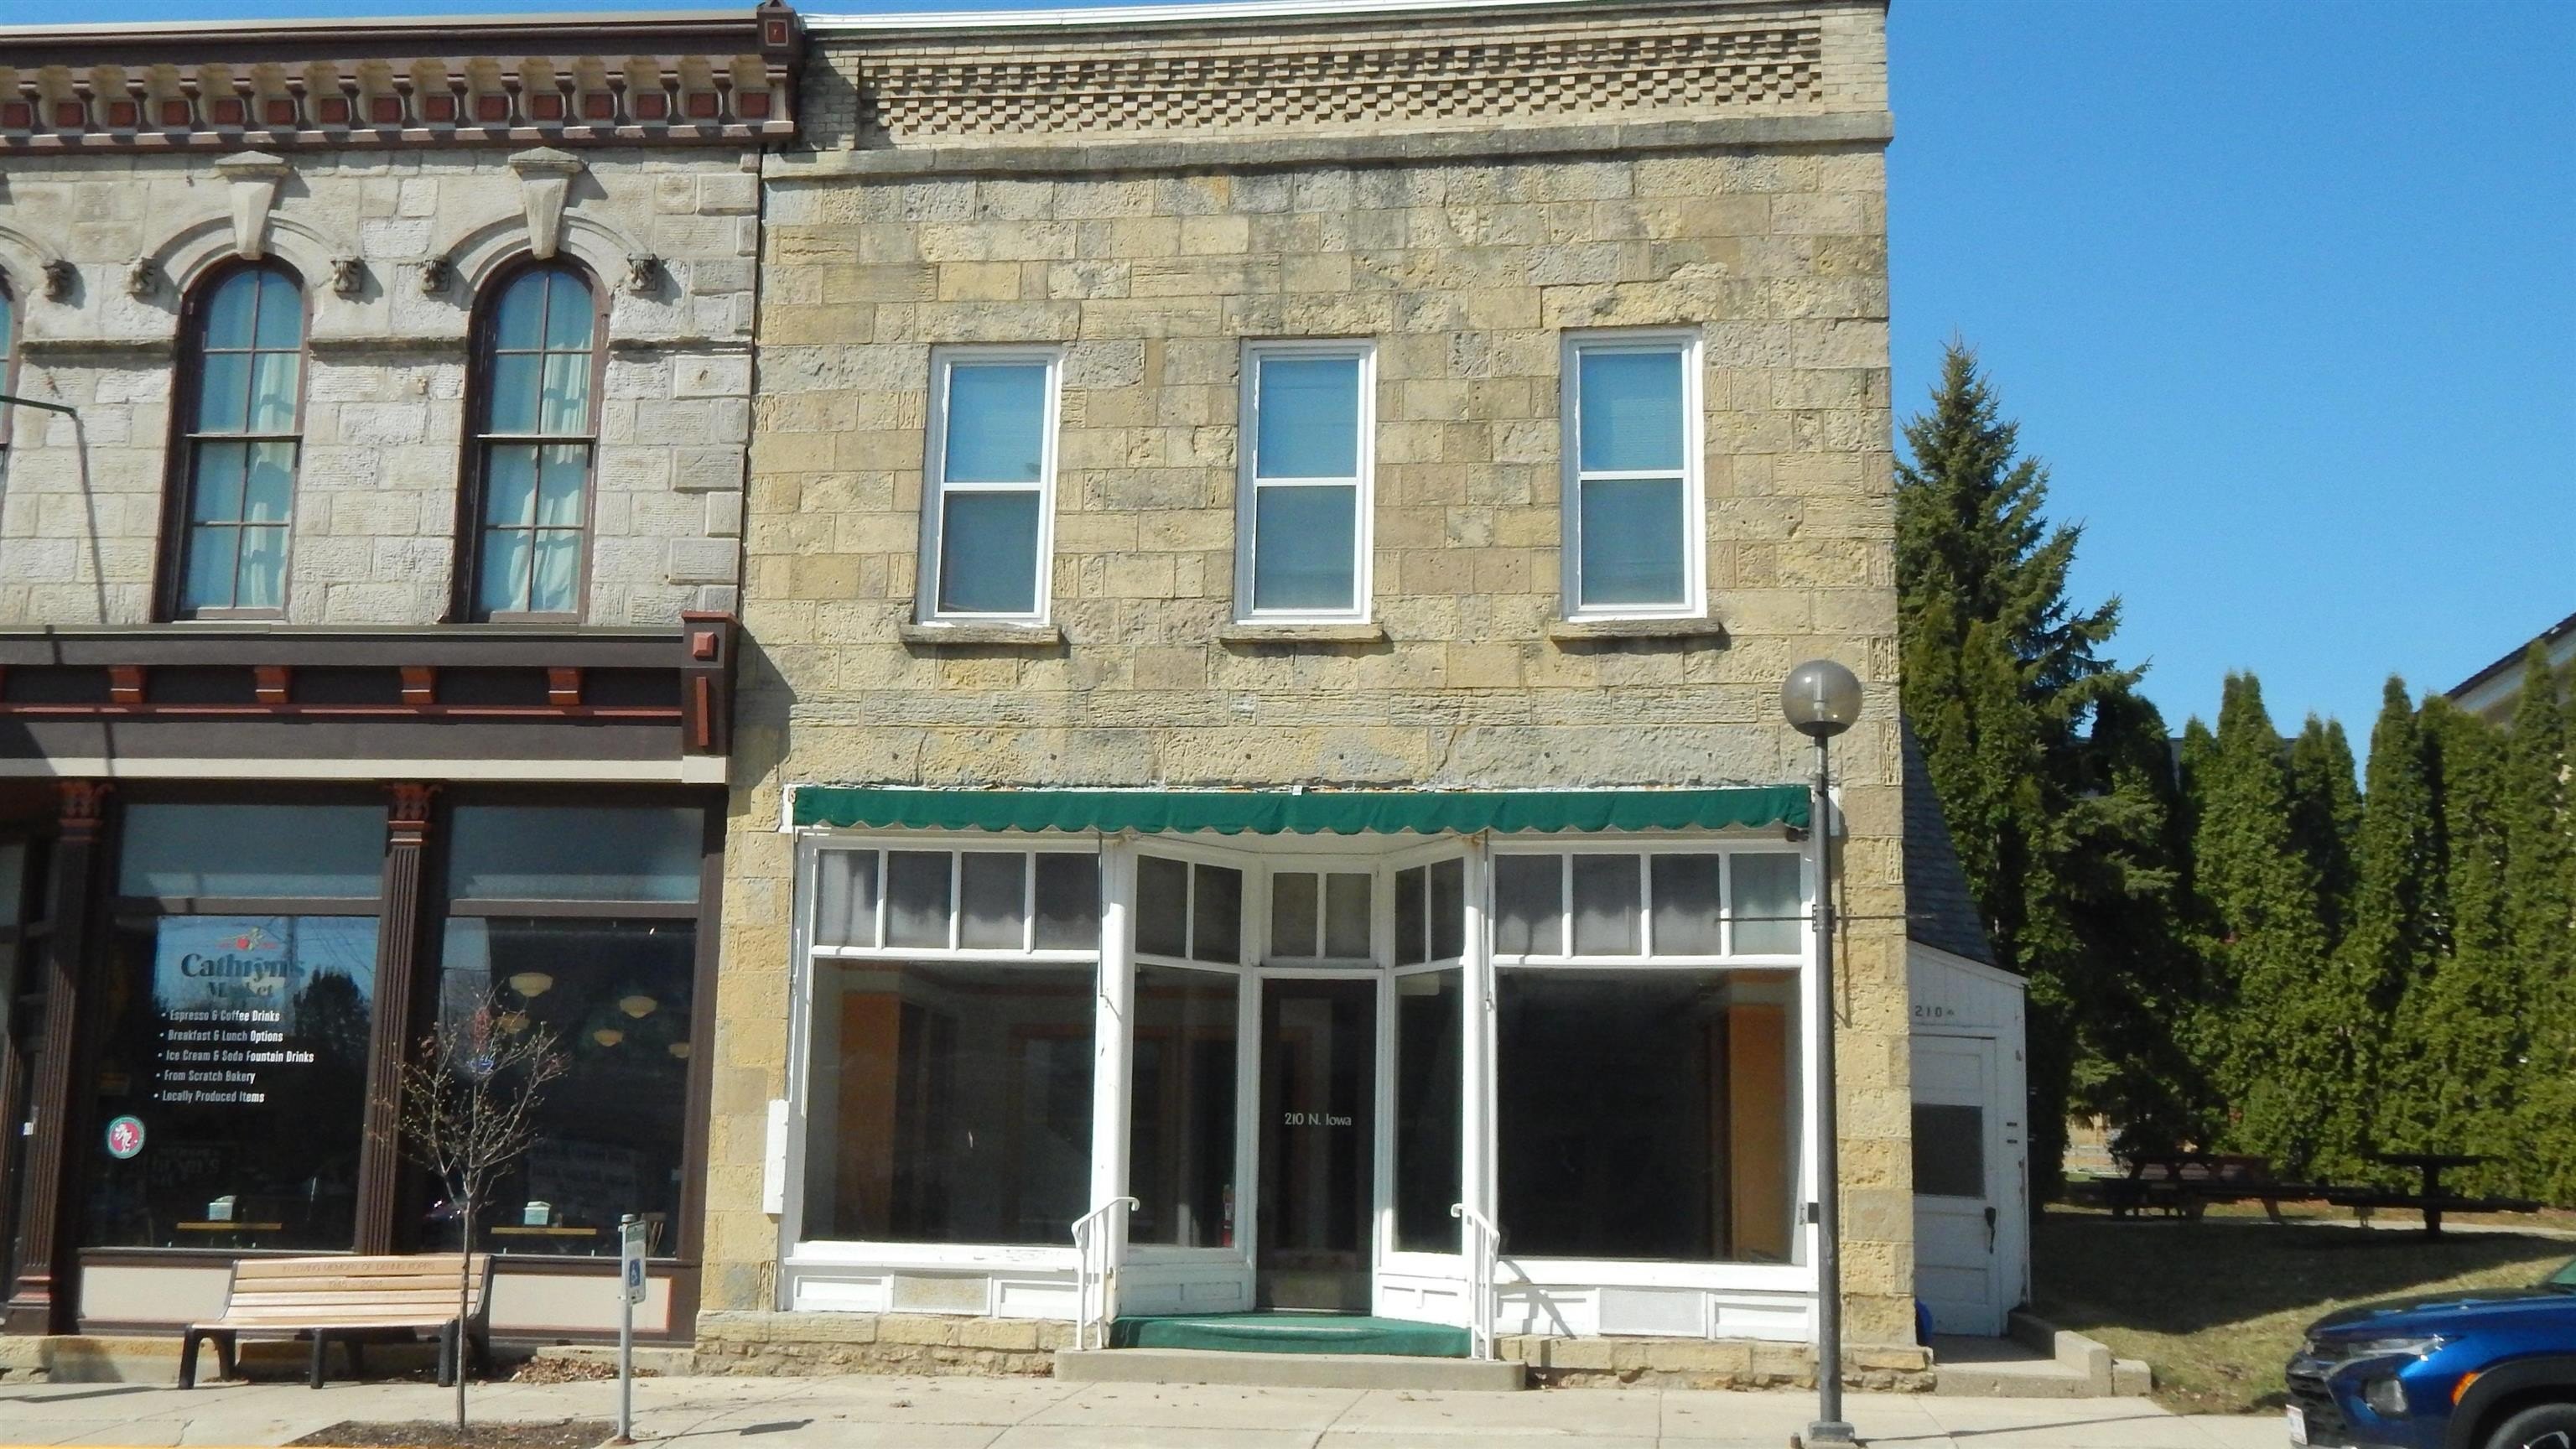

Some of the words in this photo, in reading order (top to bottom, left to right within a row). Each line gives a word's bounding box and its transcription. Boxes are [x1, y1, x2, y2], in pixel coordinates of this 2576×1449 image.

[181, 953, 305, 982] Cathryn's
[208, 982, 274, 998] Mket
[170, 1010, 209, 1022] Espresso
[221, 1010, 250, 1021] Coffee
[252, 1010, 280, 1022] Drinks
[168, 1029, 210, 1041] Breakfast
[222, 1030, 247, 1041] Lunch
[251, 1030, 283, 1044] Options
[166, 1049, 180, 1061] Ice
[183, 1049, 210, 1062] Cream
[222, 1050, 243, 1062] Soda
[247, 1050, 283, 1062] Fountain
[286, 1051, 314, 1063] Drinks
[164, 1069, 185, 1081] From
[189, 1070, 223, 1082] Scratch
[226, 1070, 256, 1084] Bakery
[163, 1089, 193, 1104] Locally
[195, 1091, 236, 1102] Produced
[239, 1091, 265, 1103] Items
[1285, 1113, 1304, 1125] 210
[1308, 1113, 1322, 1125] N.
[1326, 1114, 1352, 1125] Iowa
